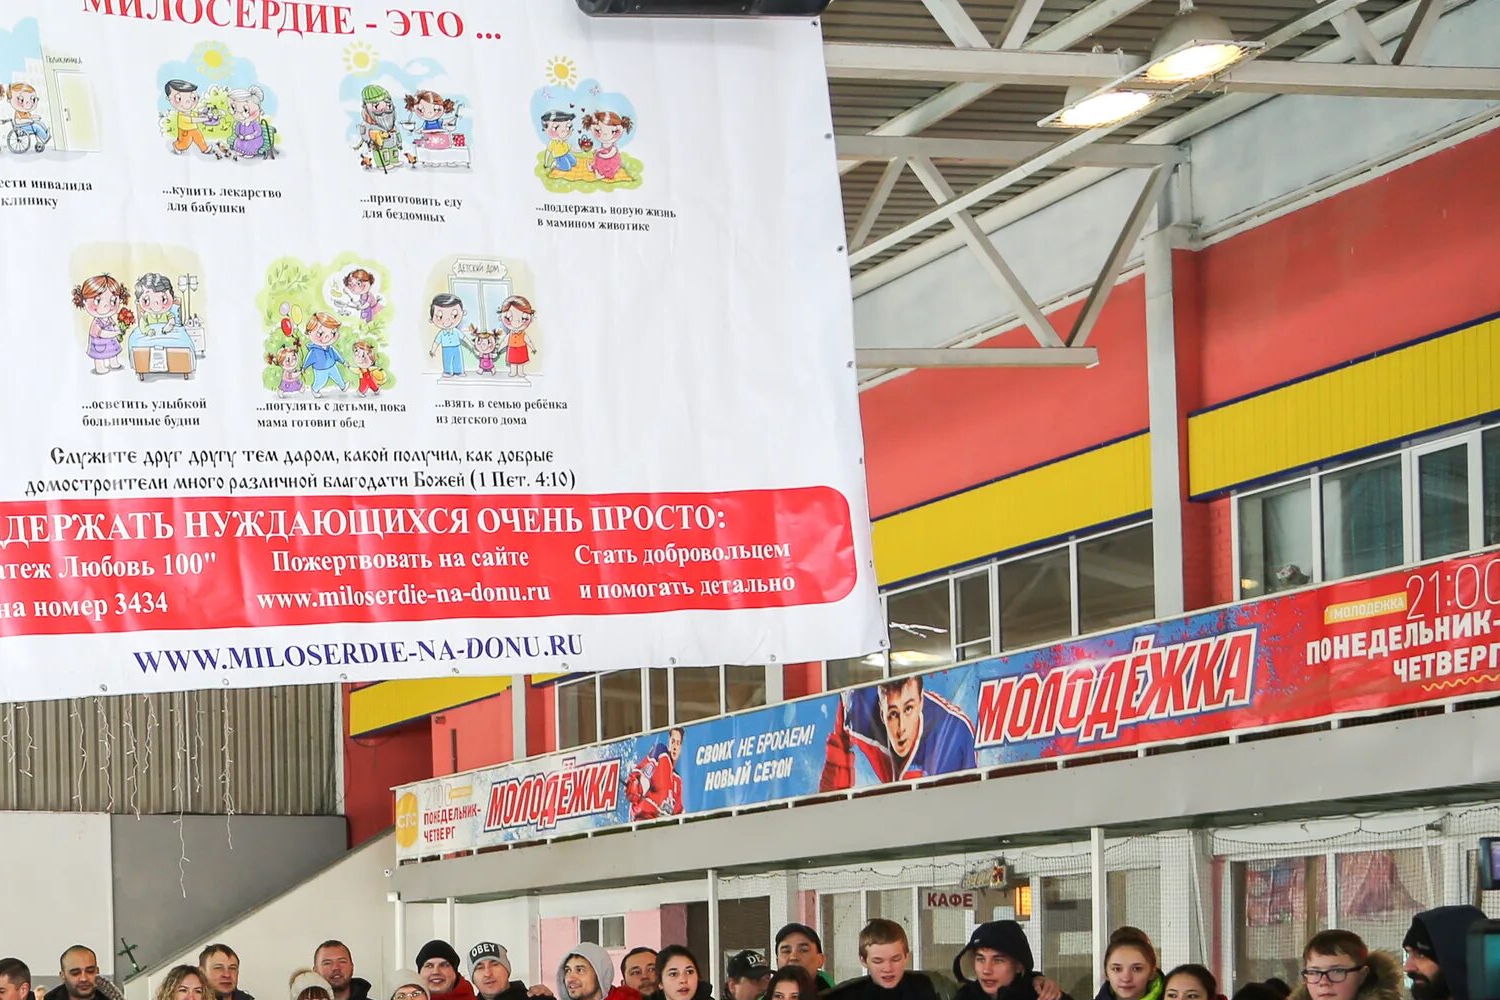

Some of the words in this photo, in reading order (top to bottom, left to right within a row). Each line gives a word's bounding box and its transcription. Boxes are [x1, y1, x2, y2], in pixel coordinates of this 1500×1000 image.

[384, 9, 464, 38] ЭТО
[31, 180, 93, 192] инвалида
[219, 187, 282, 200] лекарство
[167, 201, 188, 213] для
[191, 201, 246, 216] бабушки
[444, 198, 463, 210] еду
[610, 205, 644, 218] новую
[645, 207, 677, 219] жизнь
[362, 209, 383, 219] для
[385, 208, 446, 223] бездомных
[537, 217, 544, 226] в
[546, 219, 596, 229] мамином
[598, 221, 651, 232] животике
[151, 397, 207, 413] улыбкой
[324, 402, 331, 412] с
[333, 402, 378, 414] детьми,
[380, 402, 407, 413] пока
[478, 400, 485, 409] в
[487, 399, 522, 410] семью
[524, 398, 568, 412] ребёнка
[82, 414, 161, 427] больничные
[164, 414, 201, 430] будни
[257, 418, 288, 428] мама
[291, 417, 339, 428] готовит
[340, 416, 365, 429] обед
[436, 414, 449, 424] из
[450, 413, 499, 426] детского
[500, 414, 527, 426] дома
[50, 447, 138, 469] Служите
[143, 450, 183, 468] друг
[188, 449, 238, 468] другу
[242, 449, 279, 463] тем
[283, 448, 339, 467] даром,
[344, 446, 389, 463] какой
[393, 448, 462, 468] получил,
[466, 449, 493, 462] как
[497, 447, 554, 467] добрые
[25, 476, 168, 496] домостроители
[173, 475, 224, 489] много
[229, 473, 317, 494] различной
[323, 474, 408, 492] благодати
[413, 470, 465, 488] Божей
[491, 471, 530, 488] Пет.
[535, 469, 576, 491] 4:10)
[183, 507, 470, 544] НУЖДАЮЩИХСЯ
[477, 504, 583, 534] ОЧЕНЬ
[590, 502, 726, 532] ПРОСТО:
[272, 549, 433, 578] Пожертвовать
[438, 552, 466, 569] на
[469, 547, 529, 568] сайте
[574, 544, 638, 566] Стать
[643, 541, 791, 569] добровольцем
[58, 555, 155, 580] Любовь
[257, 582, 551, 612] www.miloserdie-na-donu.ru
[579, 583, 592, 599] и
[596, 580, 695, 600] помогать
[700, 573, 796, 597] детально
[1406, 558, 1500, 621] 21:00
[33, 598, 109, 626] номер
[114, 591, 169, 616] 3434
[133, 633, 584, 675] WWW.MILOSERDIE-NA-DONU.RU
[1393, 642, 1500, 684] ЧЕТВЕРГ
[975, 627, 1259, 748] МОЛОДЁЖКА
[695, 738, 736, 766] СВОИХ
[737, 735, 756, 759] НЕ
[756, 723, 816, 756] БРОСАЕМ!
[704, 759, 752, 792] НОВЫЙ
[753, 756, 794, 784] СЕЗОН
[485, 757, 622, 832] МОЛОДЁЖКА
[397, 813, 417, 830] СТС
[423, 825, 456, 844] ЧЕТВЕРГ
[927, 892, 973, 908] КАФЕ
[470, 942, 496, 957] OBEY
